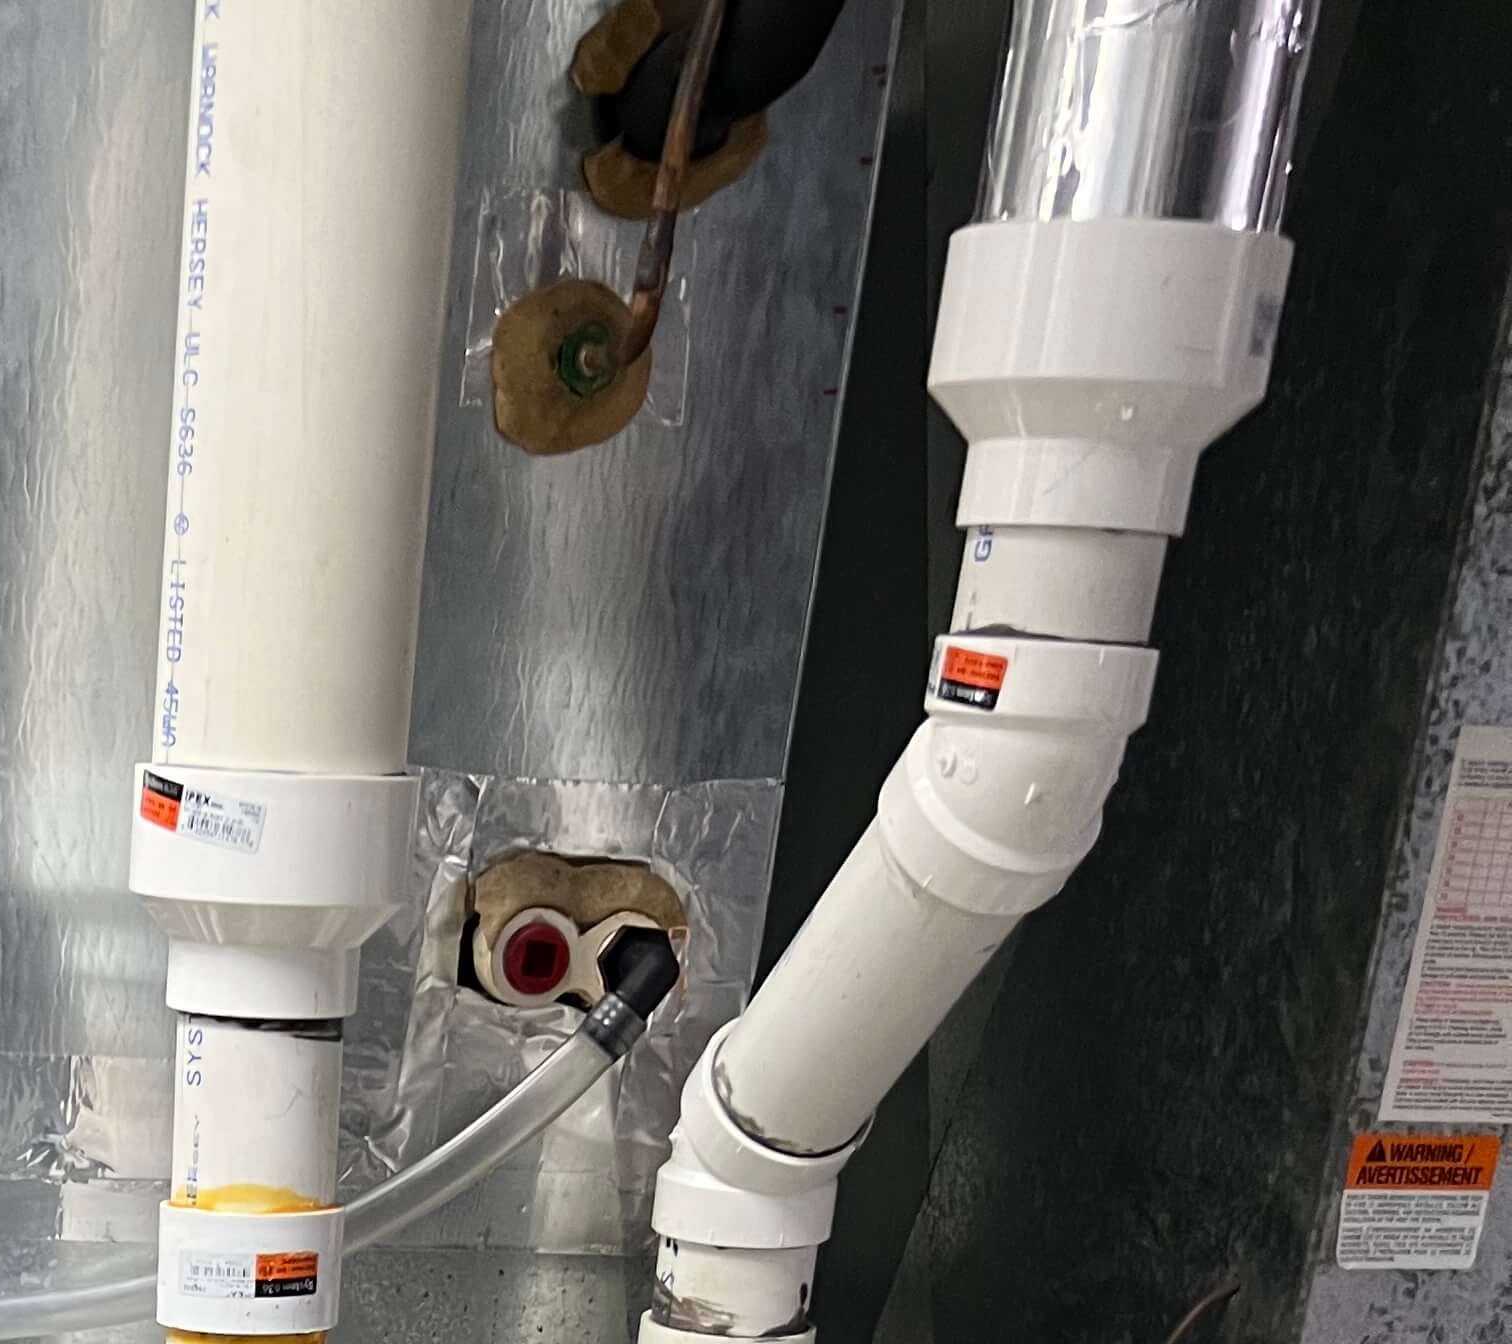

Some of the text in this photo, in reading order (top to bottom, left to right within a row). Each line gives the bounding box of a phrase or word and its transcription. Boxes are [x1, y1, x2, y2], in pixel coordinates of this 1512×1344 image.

[188, 198, 208, 311] HERSEY
[182, 331, 200, 388] ULC
[166, 559, 187, 664] LISTED
[1355, 1165, 1484, 1185] AVERTISSEMENT
[1390, 1143, 1464, 1164] WARNING
